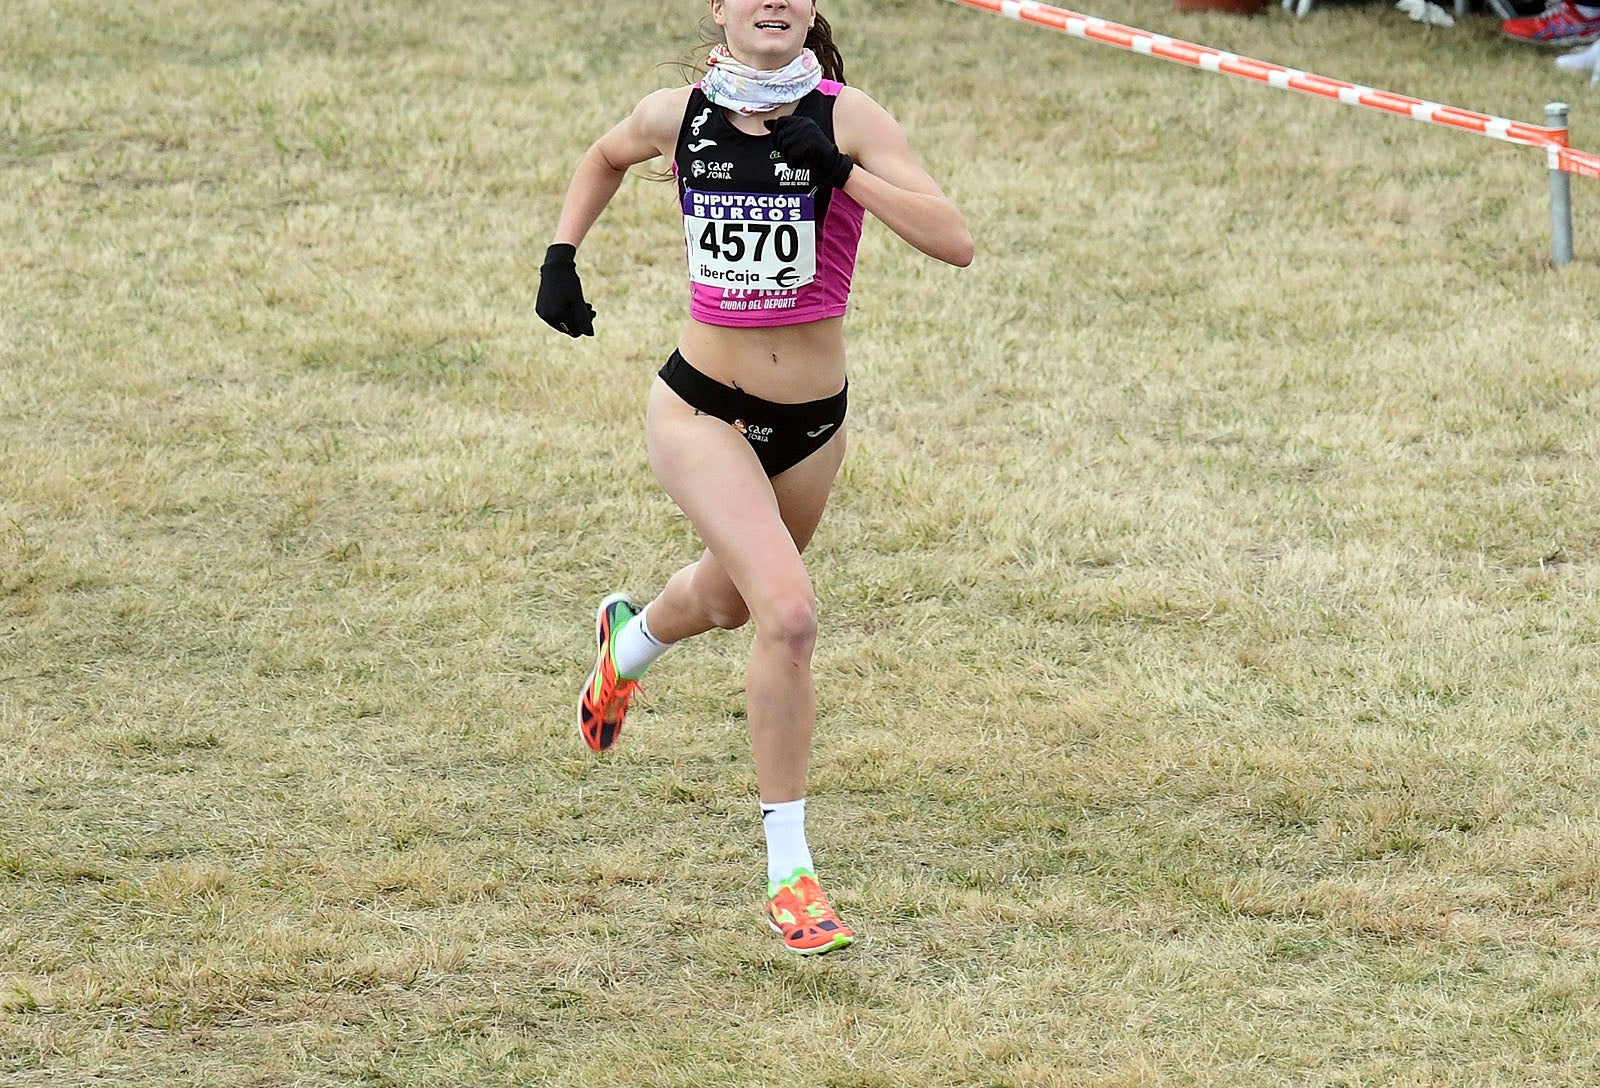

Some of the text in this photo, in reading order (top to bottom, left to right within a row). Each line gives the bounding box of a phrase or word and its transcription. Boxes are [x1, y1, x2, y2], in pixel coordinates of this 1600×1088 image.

[693, 193, 801, 209] DIPUTACIÓN
[693, 205, 802, 221] BURGOS
[699, 222, 800, 263] 4570
[700, 264, 761, 285] iberCaja
[720, 298, 797, 311] CIUDAD DEL DEPORTE
